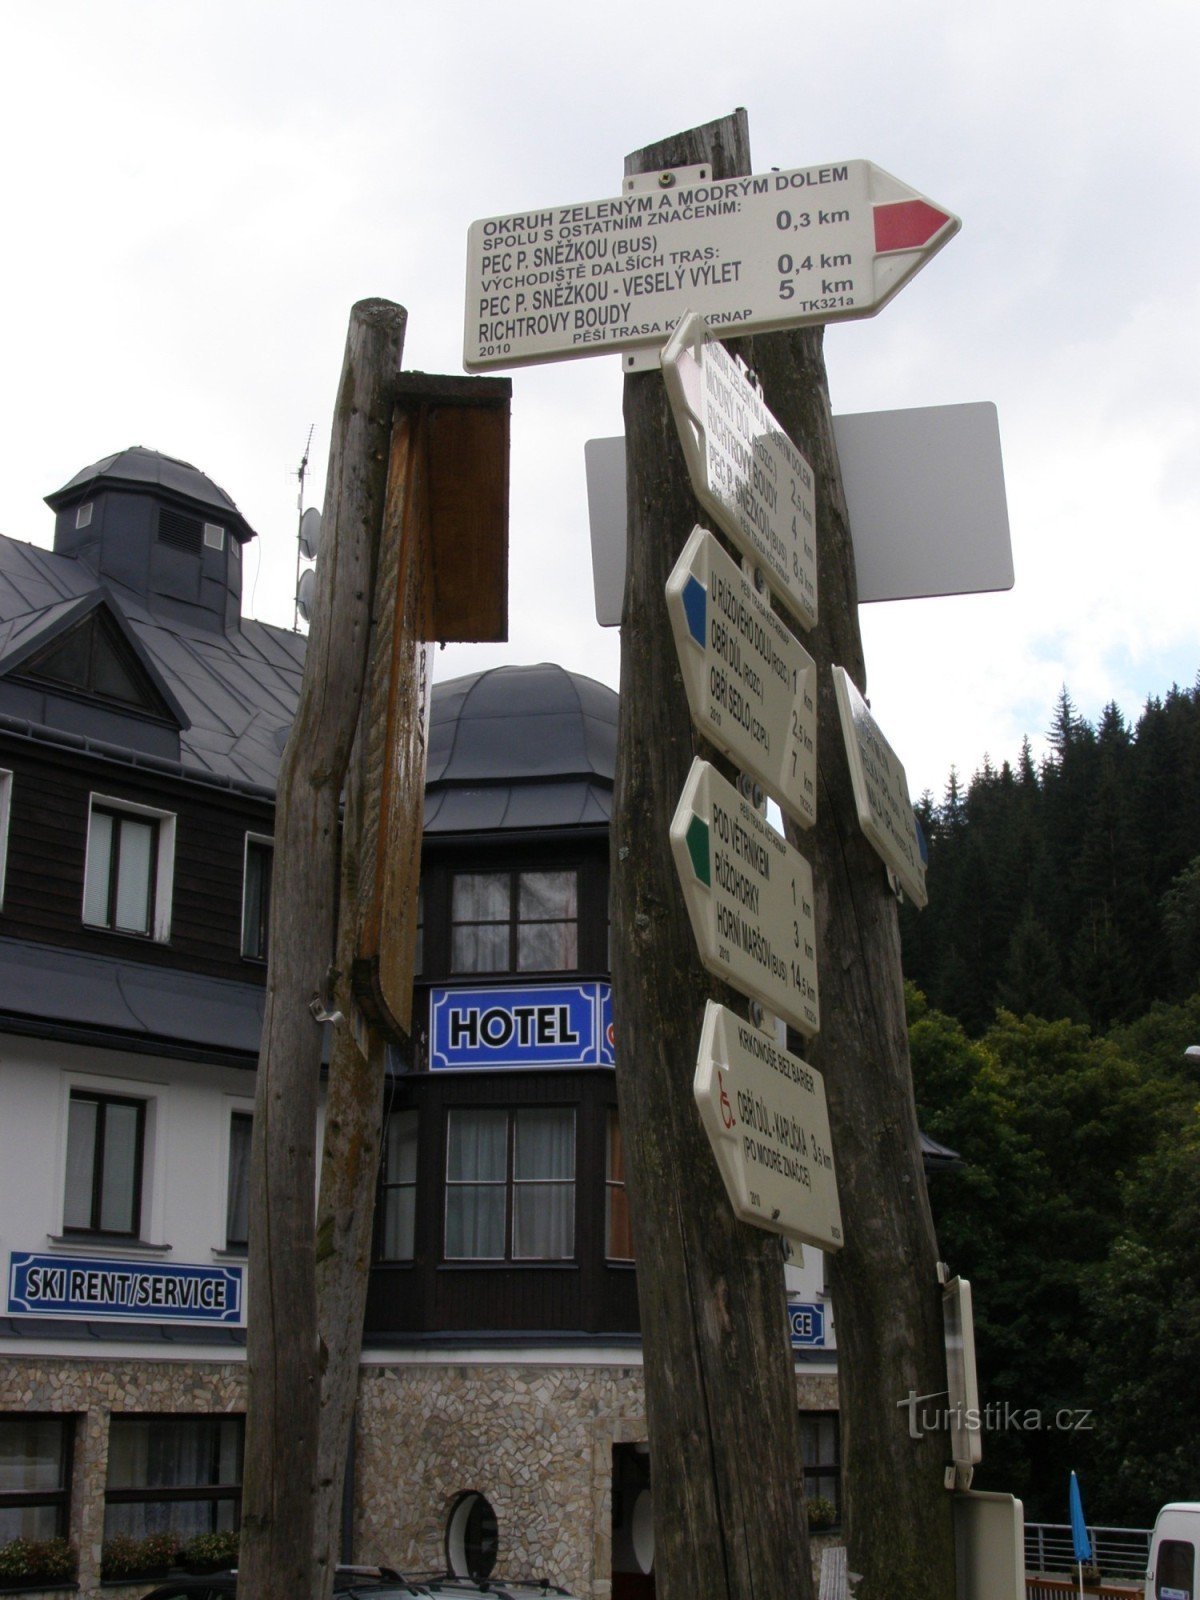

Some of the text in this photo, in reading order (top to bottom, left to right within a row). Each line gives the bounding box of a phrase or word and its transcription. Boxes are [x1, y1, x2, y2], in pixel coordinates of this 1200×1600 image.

[483, 166, 849, 236] OKRUH ZELENÝM A MODRÝM DOLEM
[481, 209, 850, 275] PEC P. SNĚŽKOU (BUS) 0,3 km
[483, 200, 742, 251] SPOLU S OSTATNÍM ZNAČENÍM:
[479, 295, 510, 318] PEC
[516, 293, 527, 313] P.
[532, 280, 608, 310] SNĚŽKOU
[623, 264, 685, 297] VESELÝ
[690, 261, 742, 287] VÝLET
[777, 253, 813, 275] 0,4
[820, 253, 852, 269] km
[481, 247, 720, 292] VÝCHODIŠTĚ DALŠÍCH TRAS:
[479, 279, 854, 343] RICHTROVY BOUDY 5 km
[799, 296, 854, 312] TK321a
[479, 344, 511, 357] 2010
[573, 327, 607, 344] PĚŠÍ
[608, 322, 661, 339] TRASA
[709, 440, 725, 486] PEC
[791, 451, 811, 491] DOLEM
[753, 460, 777, 515] BOUDY
[791, 512, 796, 542] 4
[711, 570, 716, 603] U
[728, 683, 750, 734] SEDLO
[792, 749, 797, 780] 7
[712, 802, 729, 845] POD
[791, 877, 796, 906] 1
[717, 902, 741, 949] HORNÍ
[793, 919, 799, 949] 3
[449, 1005, 580, 1049] HOTEL
[777, 1053, 791, 1079] BEZ
[26, 1266, 227, 1309] SKI RENT/SERVICE
